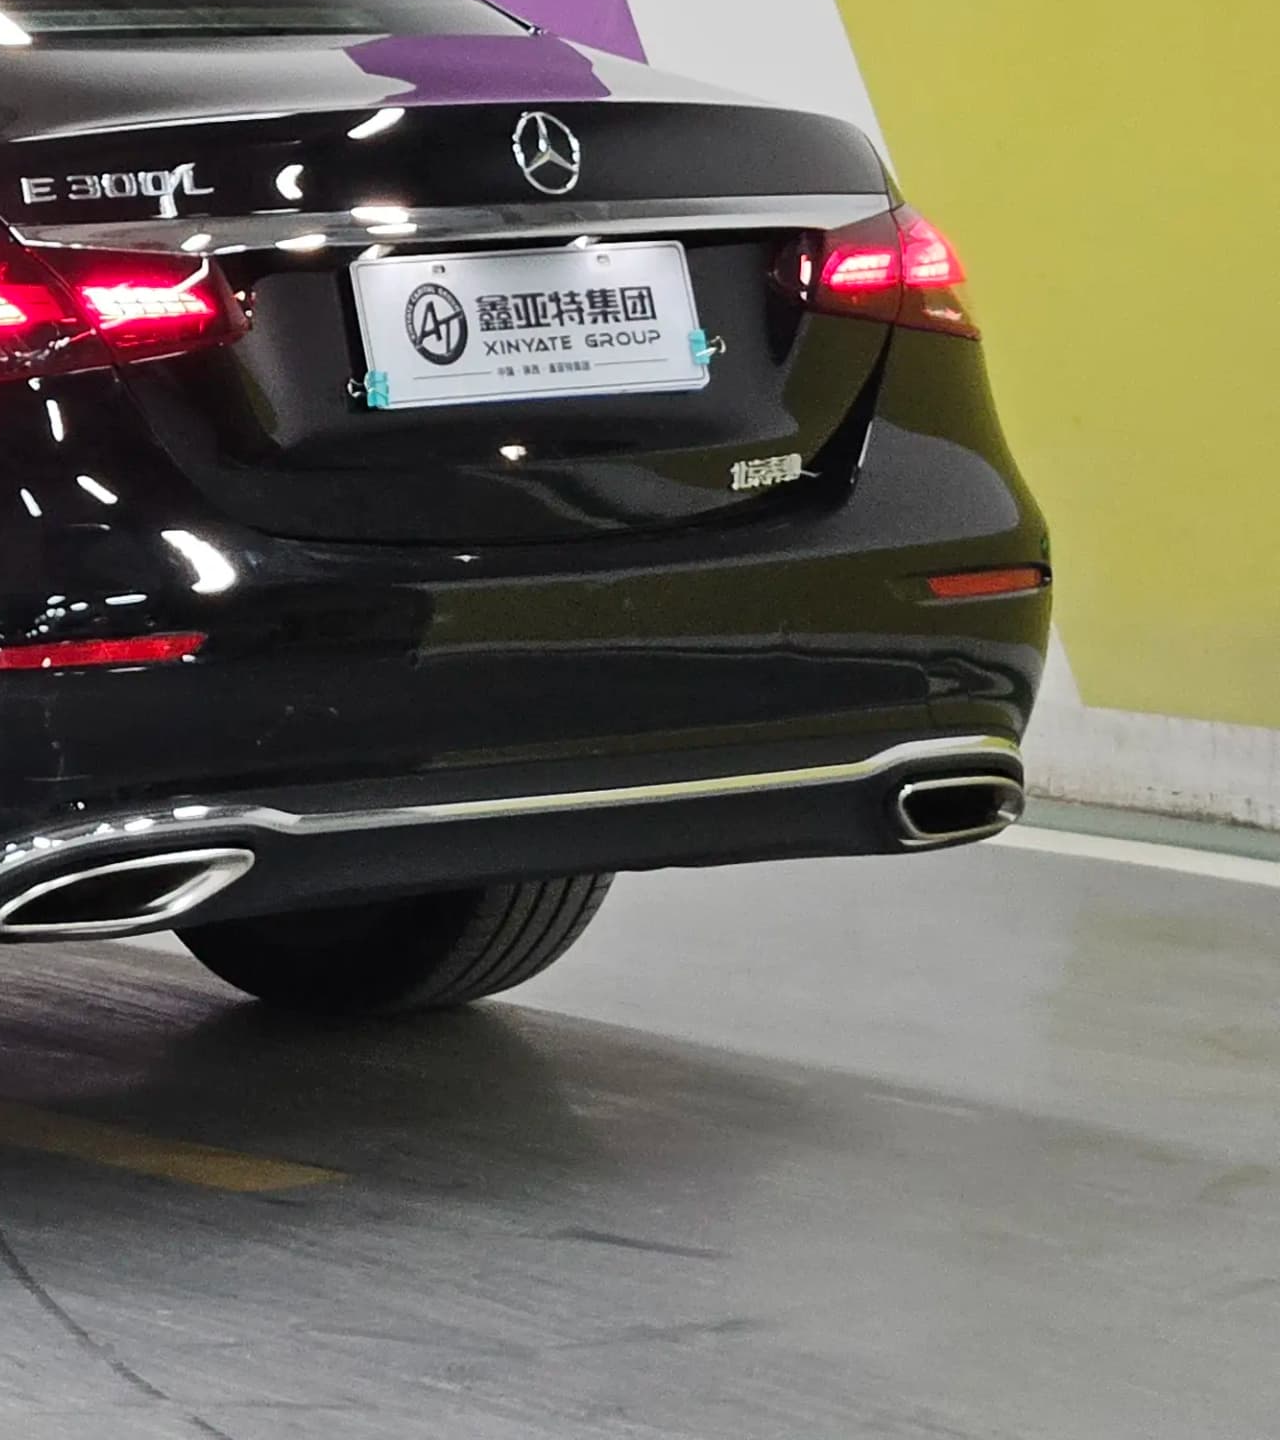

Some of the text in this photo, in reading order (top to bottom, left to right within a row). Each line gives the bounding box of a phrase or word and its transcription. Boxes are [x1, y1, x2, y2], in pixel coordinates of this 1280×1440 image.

[21, 177, 58, 205] E
[475, 286, 657, 332] 鑫亚特集团
[483, 329, 661, 356] XINYATE GROUP
